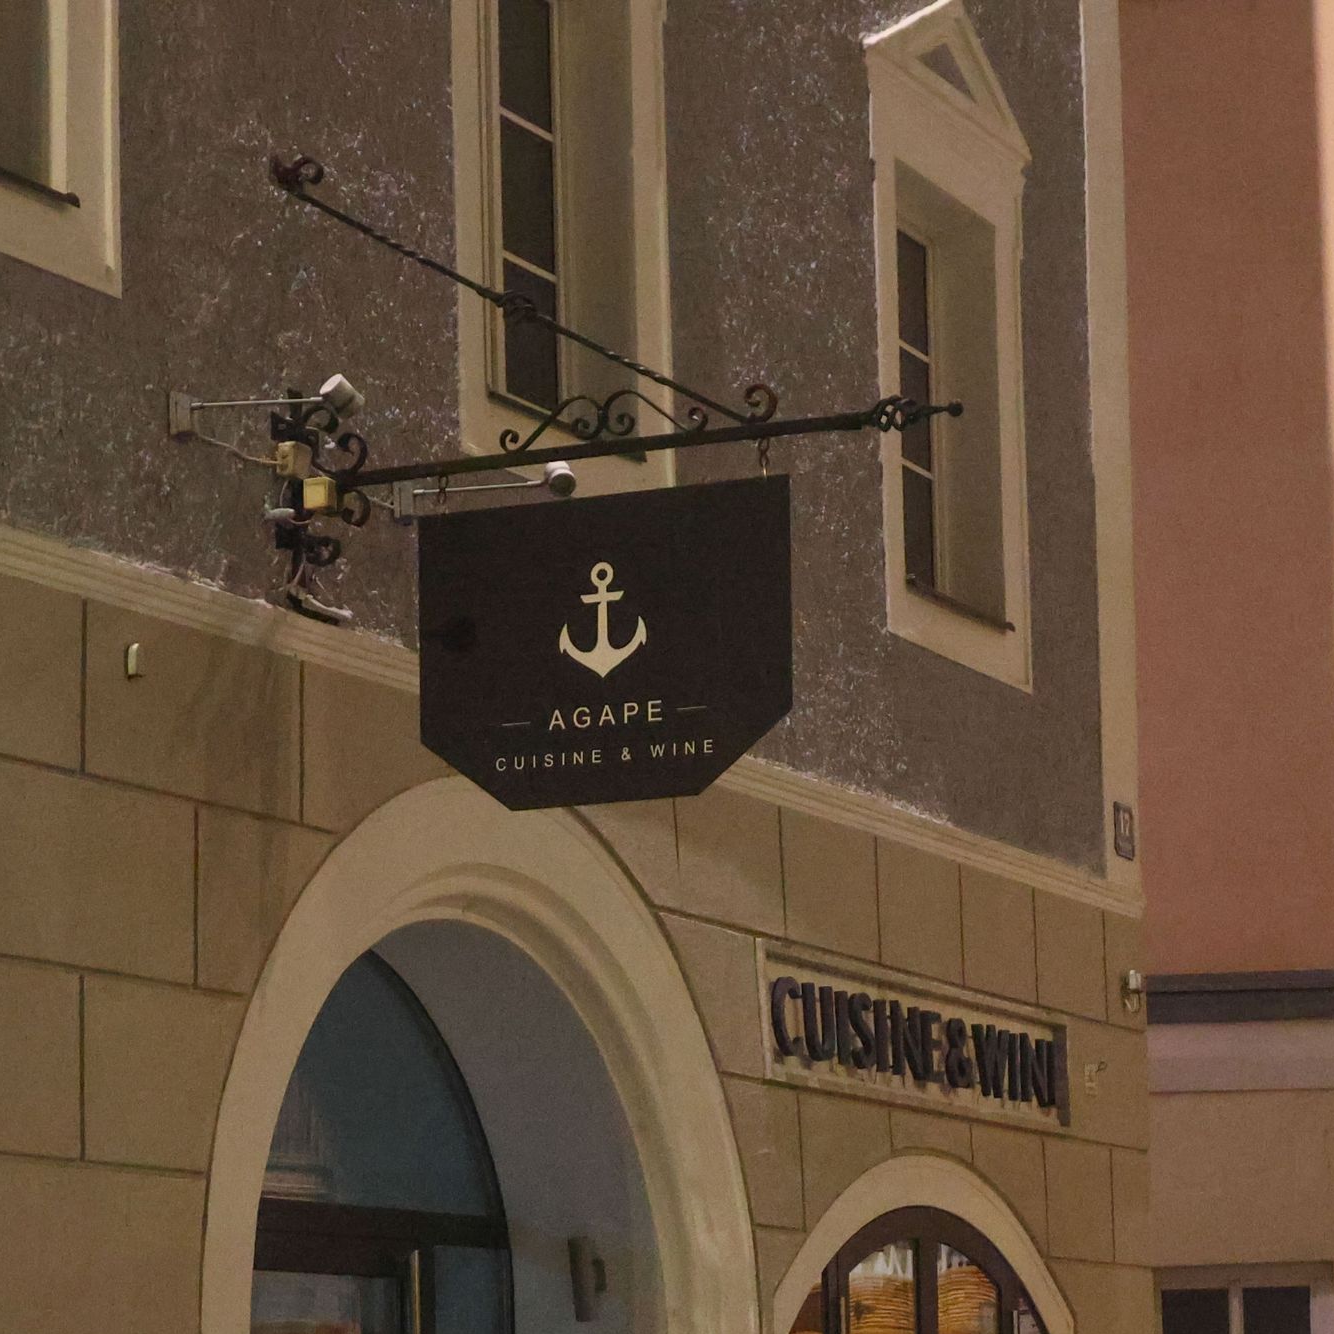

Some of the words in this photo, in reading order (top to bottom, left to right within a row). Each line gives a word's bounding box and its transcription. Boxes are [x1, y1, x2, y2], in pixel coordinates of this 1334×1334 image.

[548, 699, 663, 731] AGAPE
[495, 749, 602, 772] CUISINE
[620, 746, 632, 761] &
[649, 739, 714, 759] WINE
